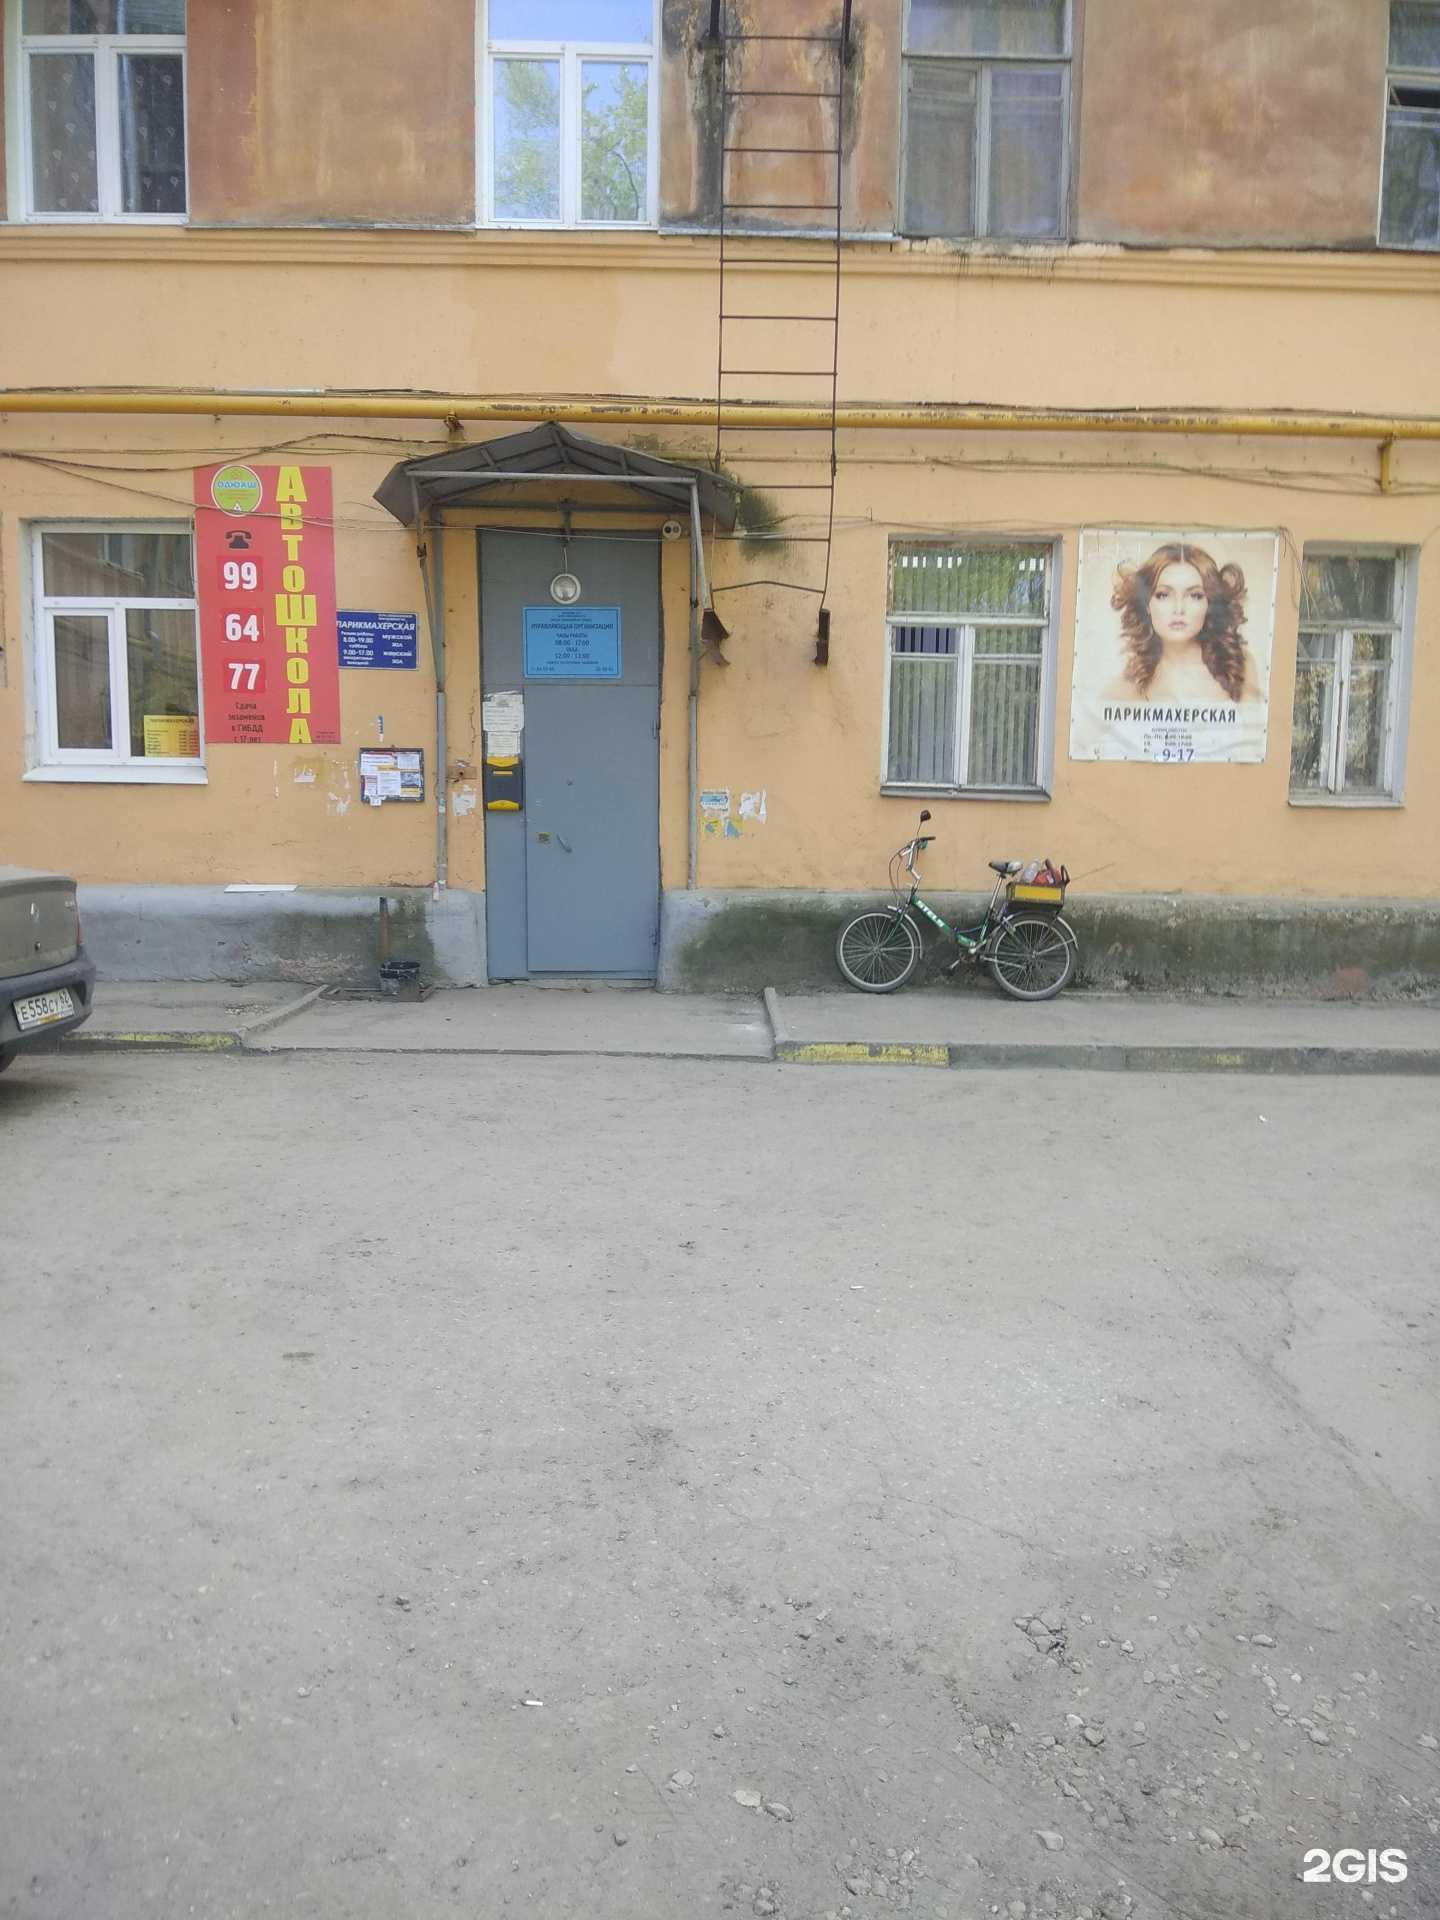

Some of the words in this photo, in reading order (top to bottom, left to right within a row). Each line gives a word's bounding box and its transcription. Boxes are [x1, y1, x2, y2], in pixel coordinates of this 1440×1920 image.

[223, 561, 258, 591] 99
[275, 465, 318, 744] АВТОШКОЛА
[225, 613, 260, 643] 64
[336, 621, 416, 631] ПАРИКМАХЕРСКАЯ
[228, 663, 260, 691] 77
[237, 723, 263, 733] ГИБДД
[1103, 706, 1237, 723] ПАРИКМАХЕРСКАЯ
